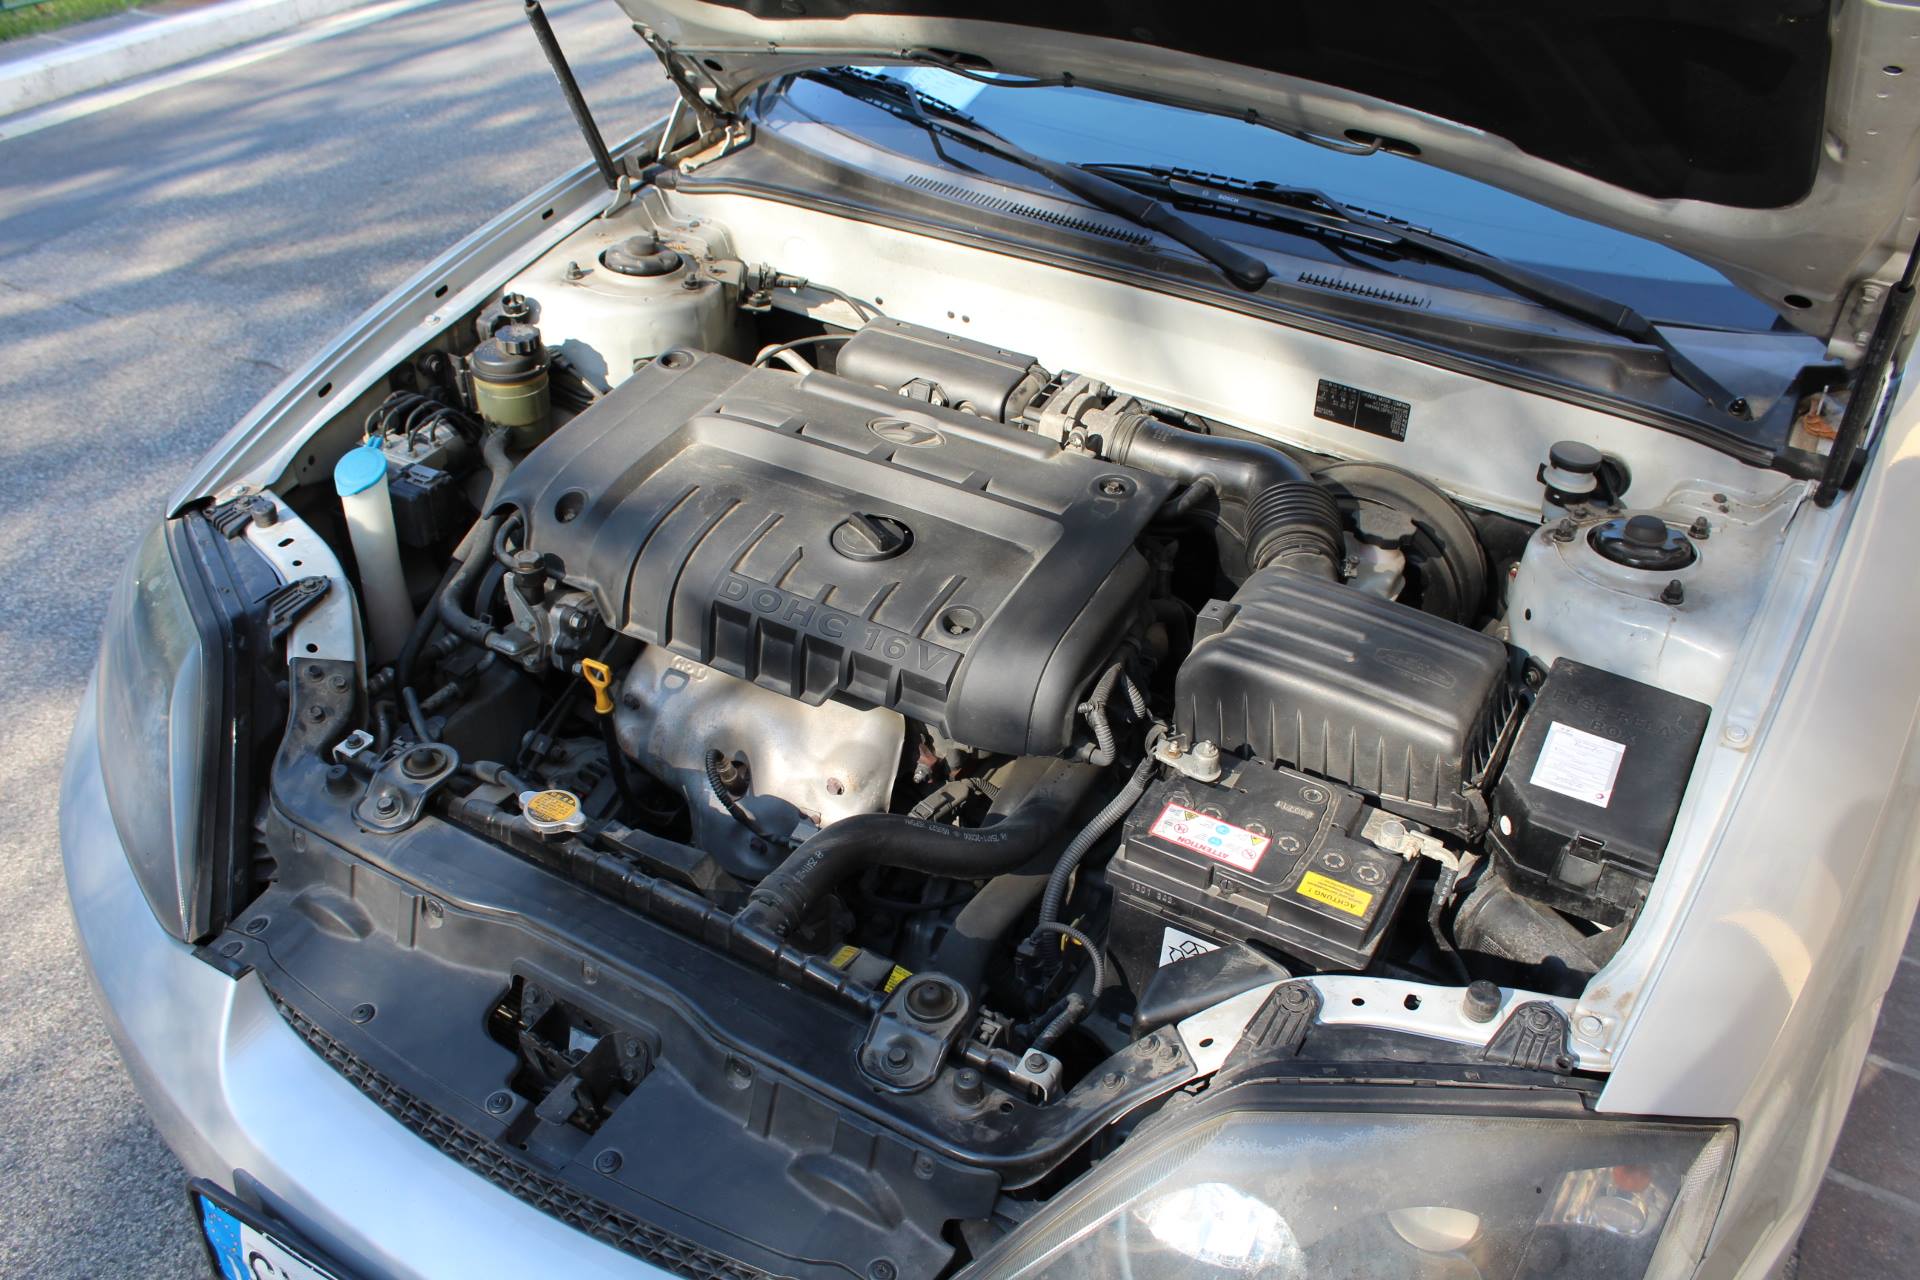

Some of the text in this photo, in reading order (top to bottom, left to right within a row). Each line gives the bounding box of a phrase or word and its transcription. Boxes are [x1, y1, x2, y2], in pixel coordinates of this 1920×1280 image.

[717, 574, 849, 638] DOHC
[1552, 688, 1609, 713] FUSE
[1590, 717, 1638, 746] BOX
[1177, 836, 1229, 859] ATTENTION
[1315, 890, 1356, 909] ACHTUNG
